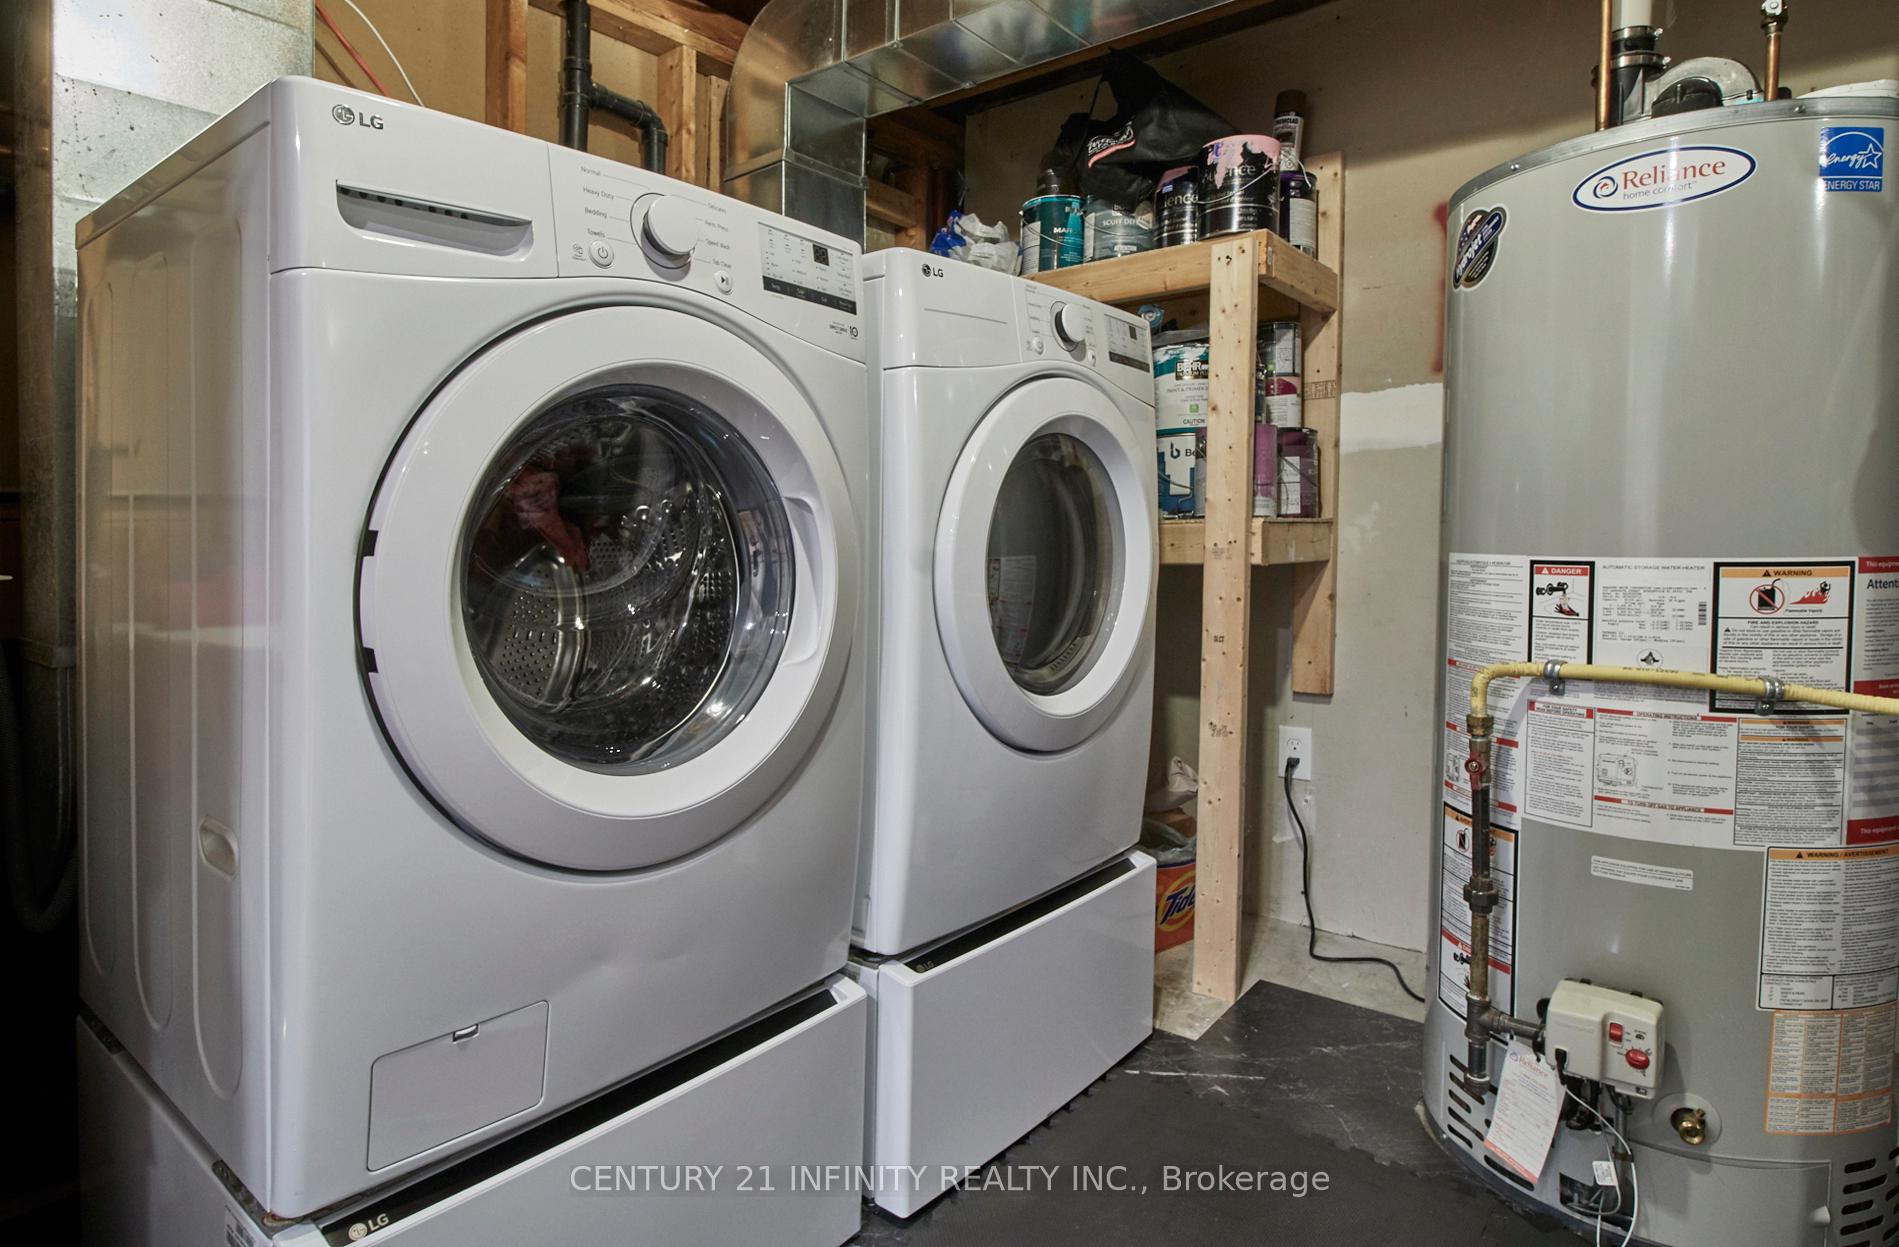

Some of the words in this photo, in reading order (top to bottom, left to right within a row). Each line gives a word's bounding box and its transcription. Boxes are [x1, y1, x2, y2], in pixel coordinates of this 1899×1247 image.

[359, 111, 384, 130] LG
[1623, 160, 1726, 191] Reliance
[1859, 181, 1880, 190] STAR
[1623, 189, 1650, 200] home
[585, 207, 608, 219] Bedding
[587, 228, 606, 238] Towels
[932, 267, 944, 278] LG
[1551, 567, 1582, 576] DANGER
[1773, 569, 1813, 577] WARNING
[368, 1213, 389, 1231] LG
